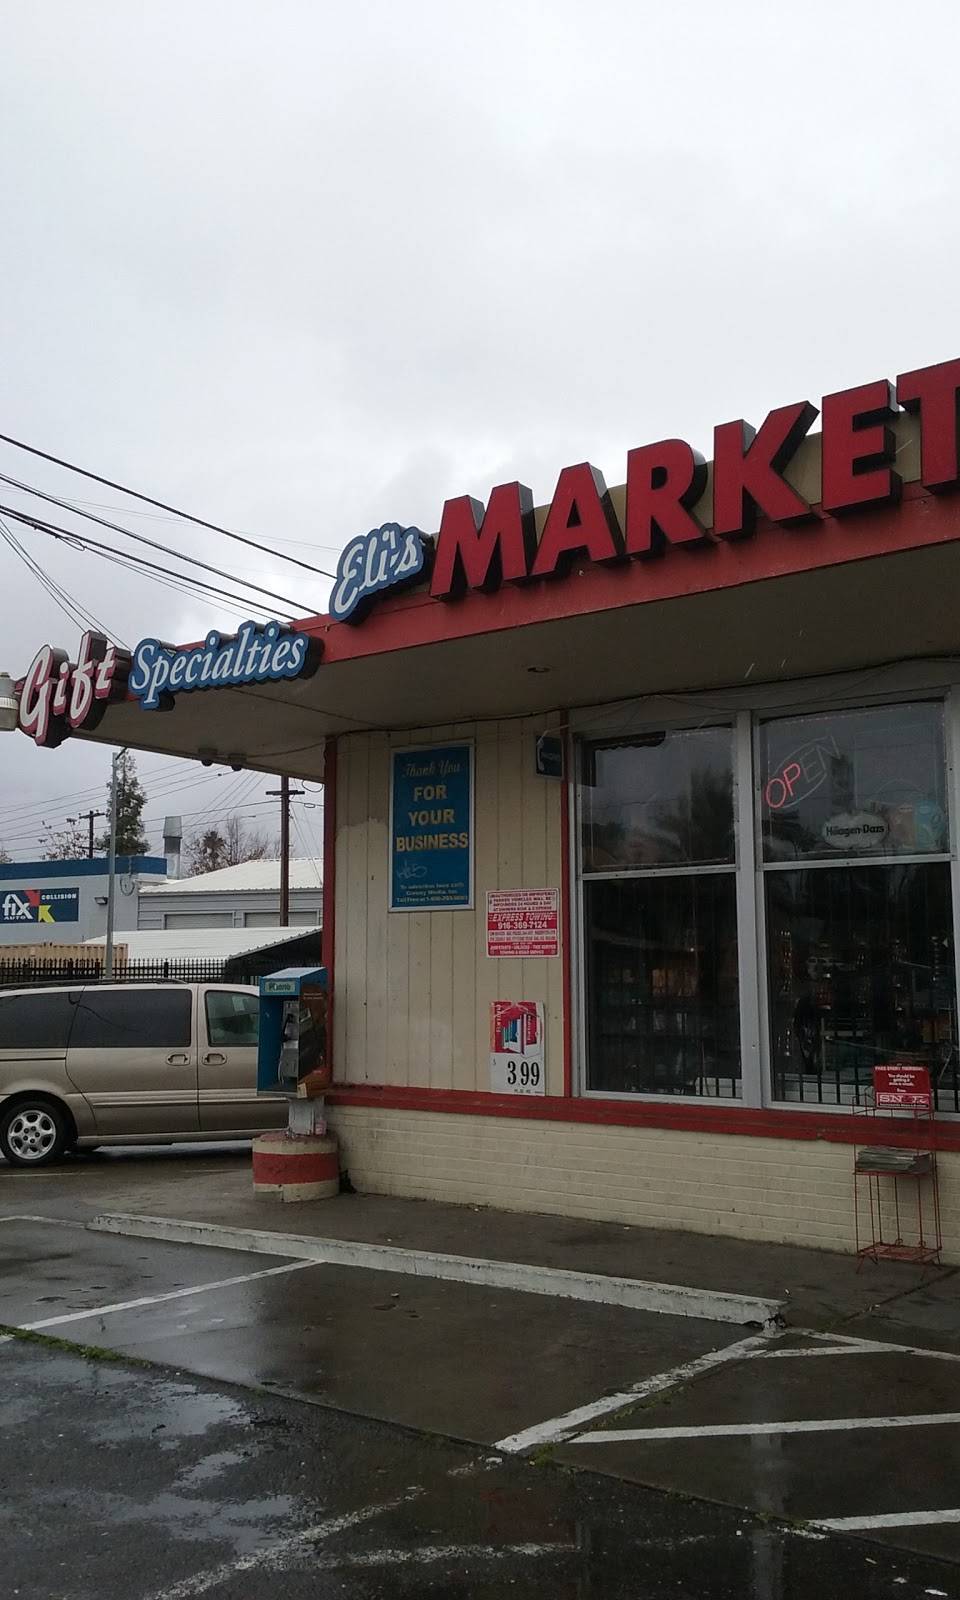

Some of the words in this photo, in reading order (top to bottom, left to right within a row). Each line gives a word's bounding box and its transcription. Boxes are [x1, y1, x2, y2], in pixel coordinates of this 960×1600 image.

[332, 528, 419, 614] Eli's
[429, 358, 960, 598] MARKET
[19, 632, 116, 744] Gift
[131, 626, 305, 704] Specialties
[402, 762, 435, 778] Thank
[438, 759, 461, 777] You
[765, 736, 840, 808] OPEN
[413, 784, 448, 801] FOR
[408, 808, 455, 826] YOUR
[396, 832, 468, 851] BUSINESS
[493, 912, 525, 922] EXPRESS
[525, 912, 554, 921] TOWING
